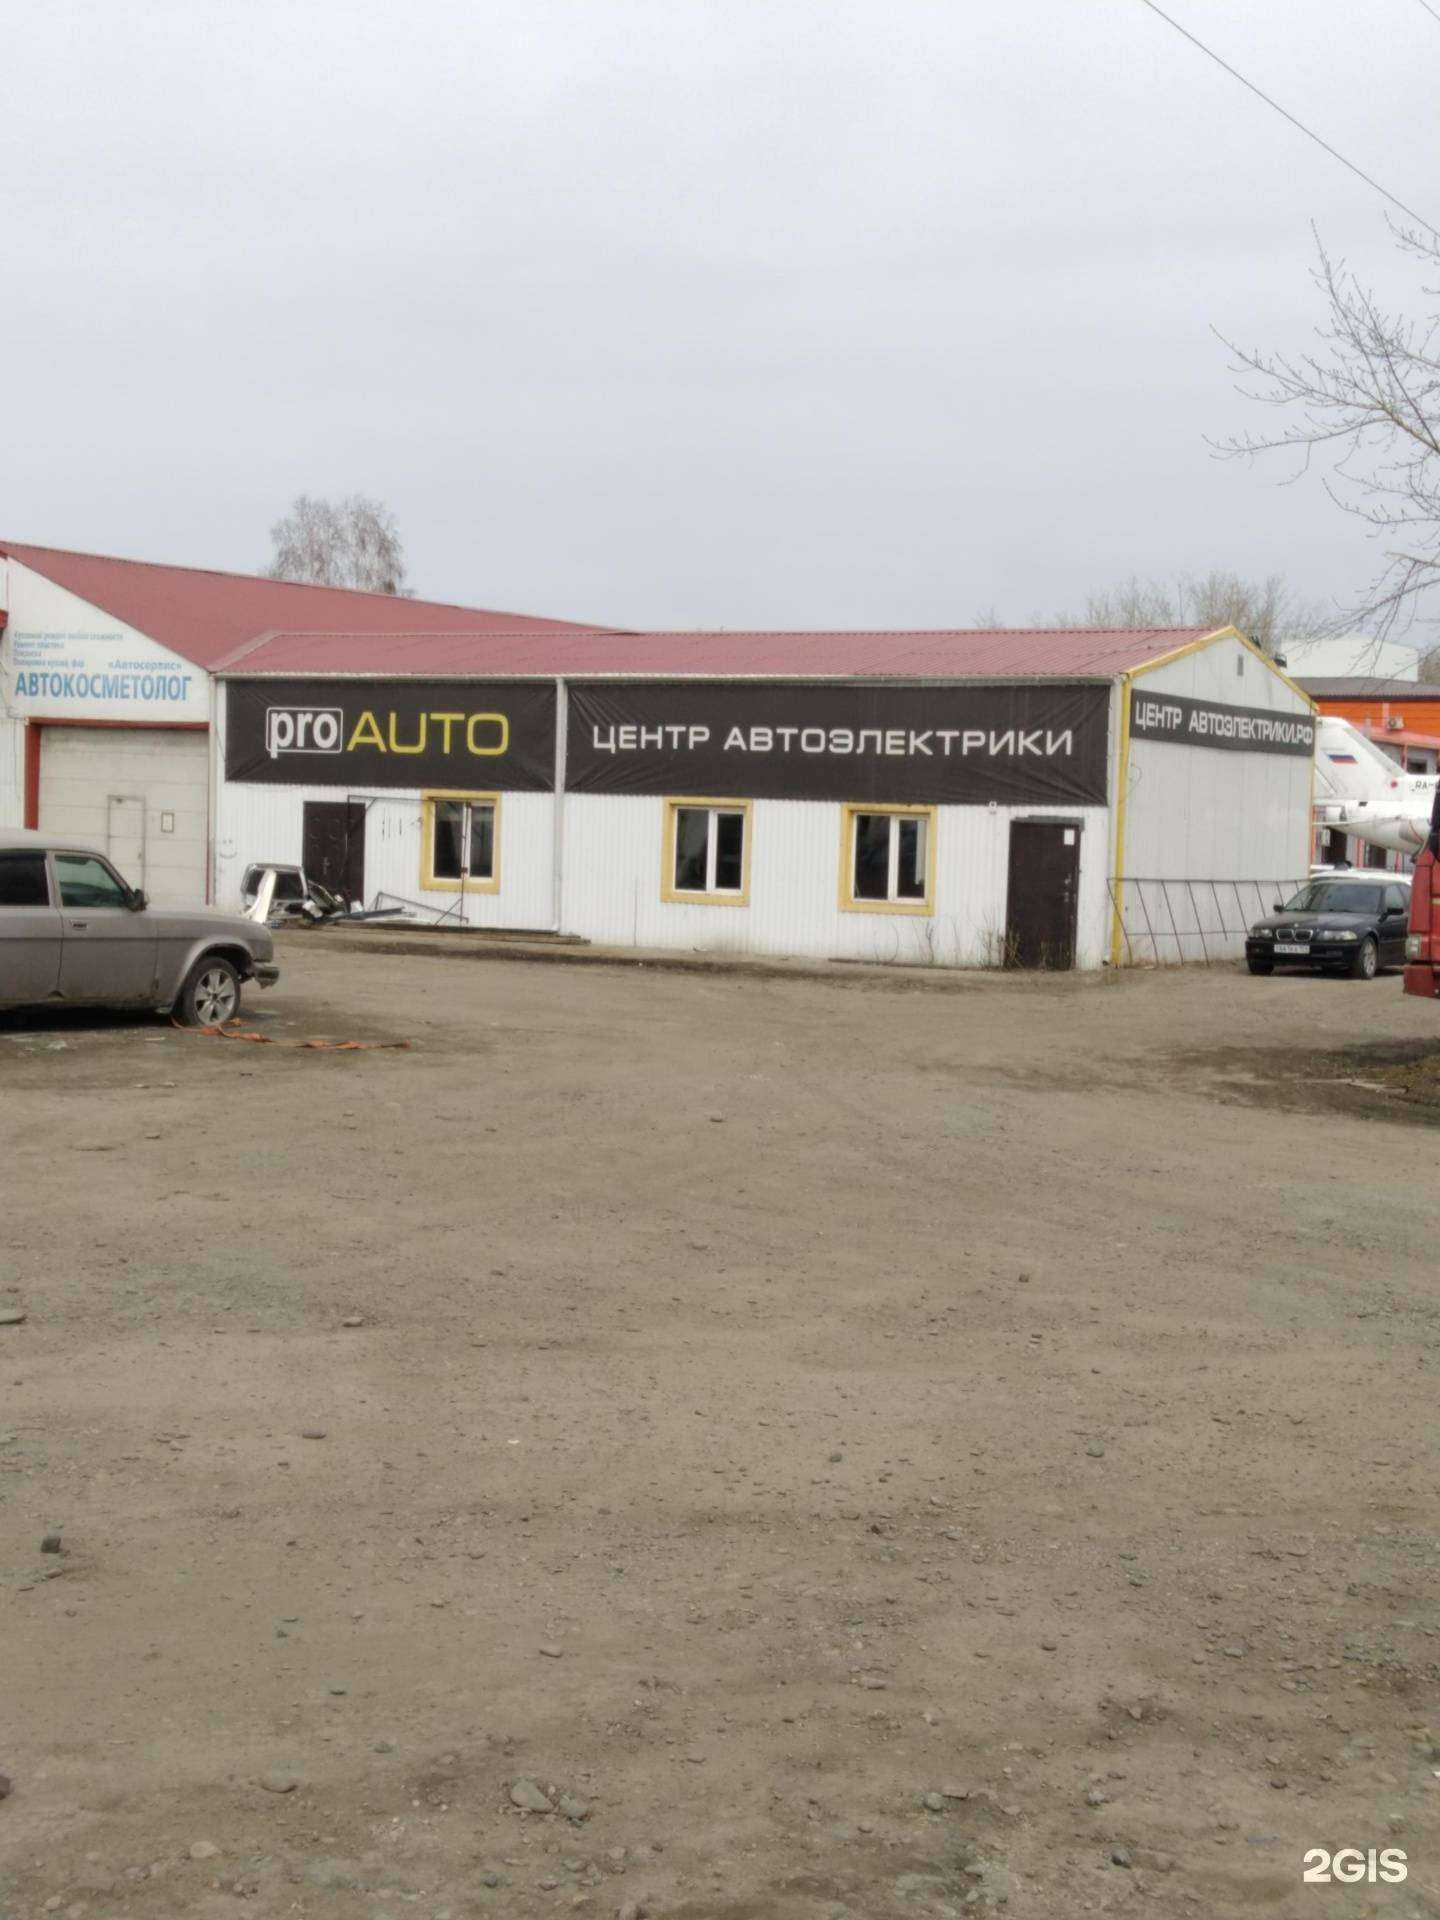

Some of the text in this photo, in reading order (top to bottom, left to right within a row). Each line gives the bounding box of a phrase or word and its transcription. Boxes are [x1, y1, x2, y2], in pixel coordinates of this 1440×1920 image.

[15, 672, 192, 701] АВТОКОСМЕТОЛОГ
[270, 711, 509, 759] pro AUTO
[592, 725, 1073, 757] ЦЕНТР АВТОЭЛЕКТРИКИ
[1135, 700, 1313, 745] ЦЕНТР АВТОЭЛЕКТРИКИ.РФ
